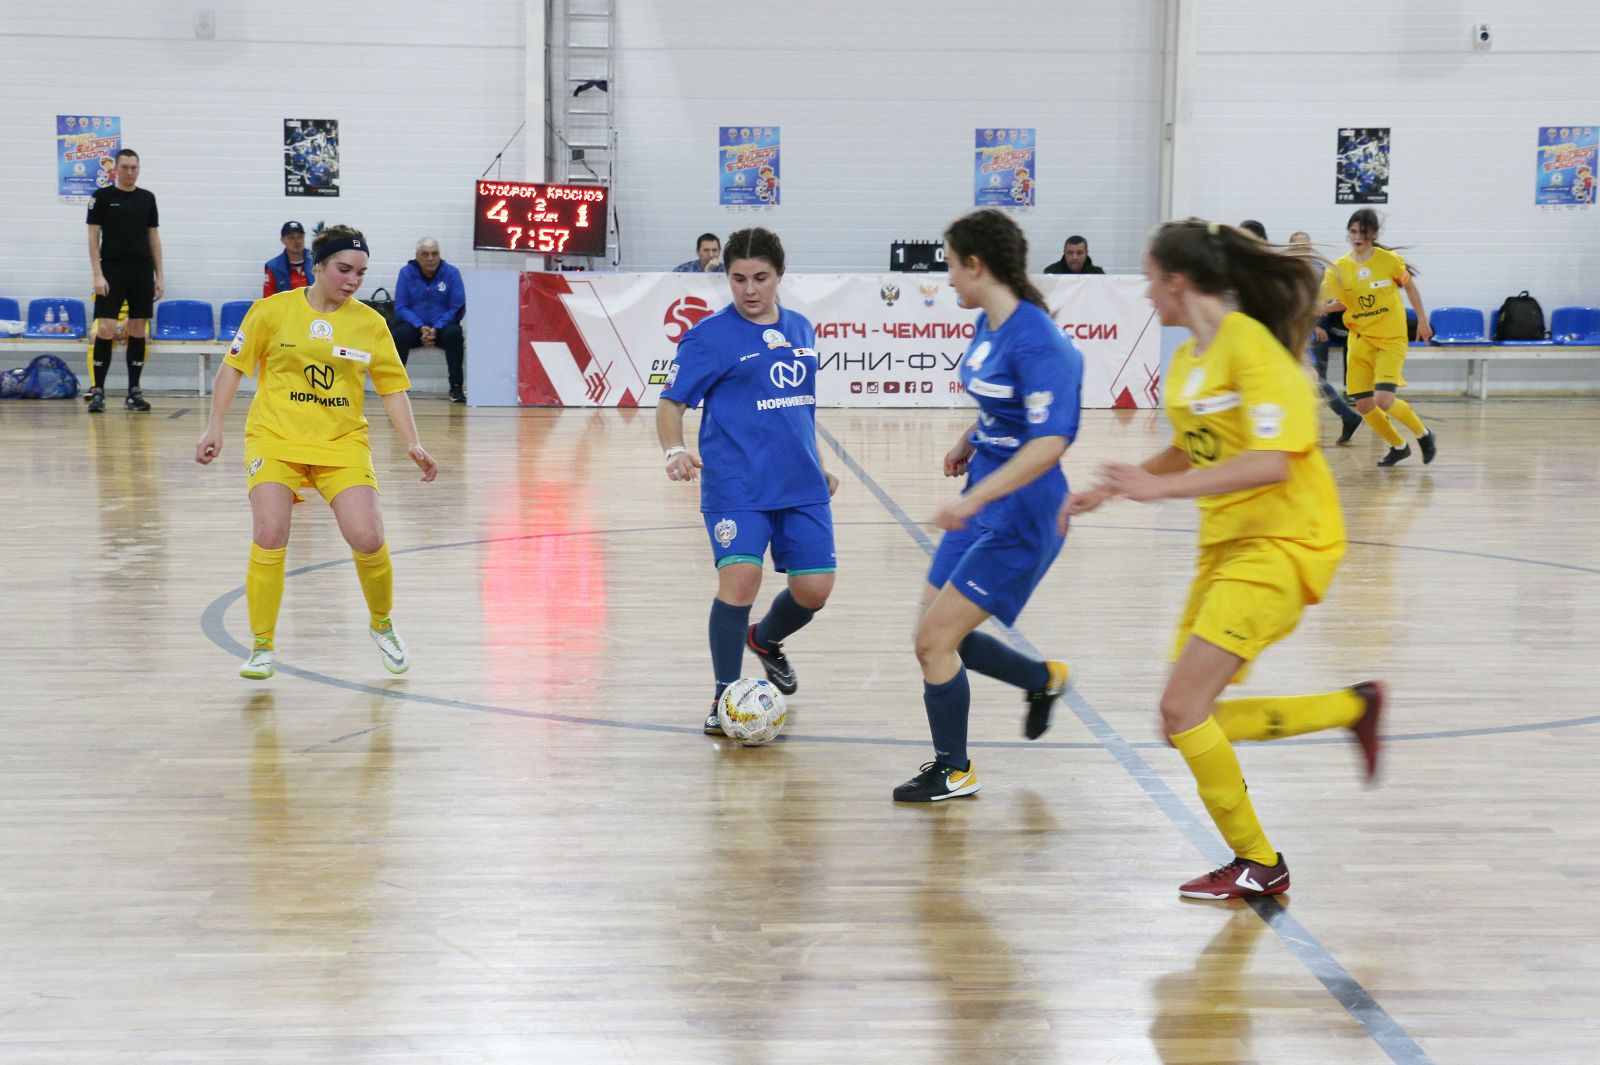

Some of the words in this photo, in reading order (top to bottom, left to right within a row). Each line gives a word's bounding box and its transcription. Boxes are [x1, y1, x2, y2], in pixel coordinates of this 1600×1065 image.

[486, 199, 509, 223] 4
[534, 198, 547, 212] 2
[575, 204, 589, 228] 1
[506, 227, 570, 253] 7:57
[896, 248, 904, 263] 1
[935, 247, 945, 263] 0
